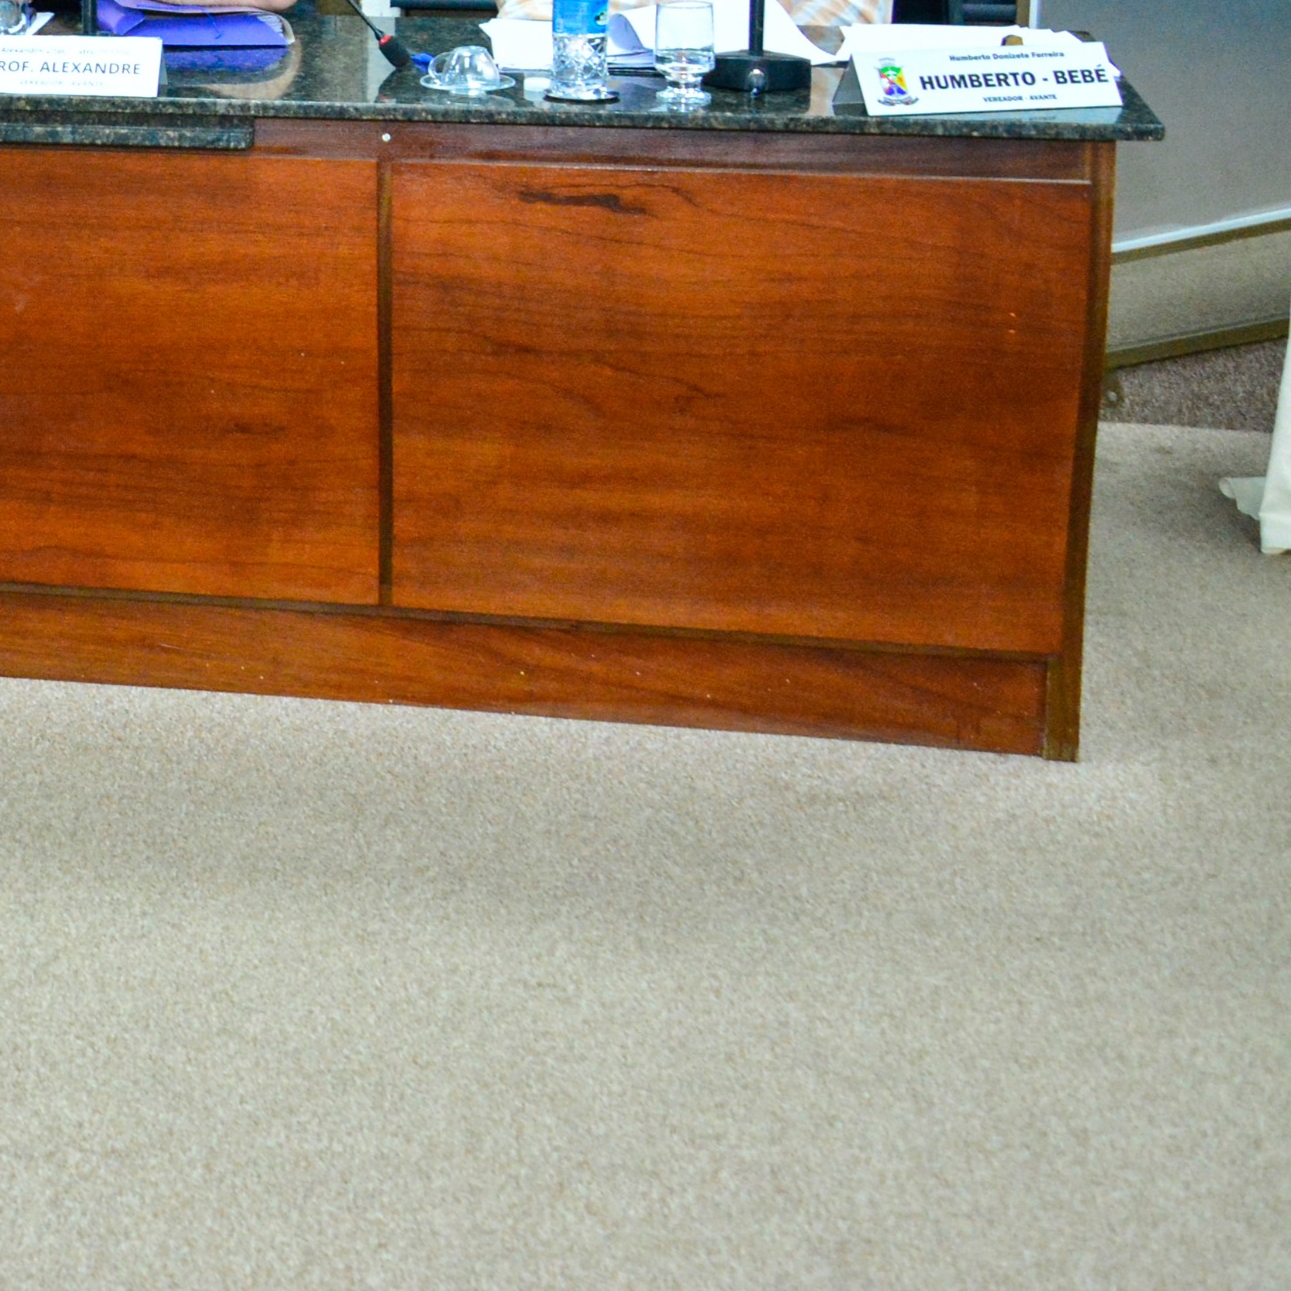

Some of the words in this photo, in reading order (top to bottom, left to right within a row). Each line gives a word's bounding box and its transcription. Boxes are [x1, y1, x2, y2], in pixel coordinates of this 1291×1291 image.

[949, 54, 991, 62] Humberto
[993, 52, 1030, 60] Donizete
[1031, 50, 1065, 58] Ferreira
[40, 61, 141, 75] ALEXANDRE
[919, 72, 1037, 90] HUMBERTO
[1053, 63, 1109, 85] BEBÉ
[982, 95, 1023, 103] VEREADOR
[1029, 93, 1057, 101] AVANTE
